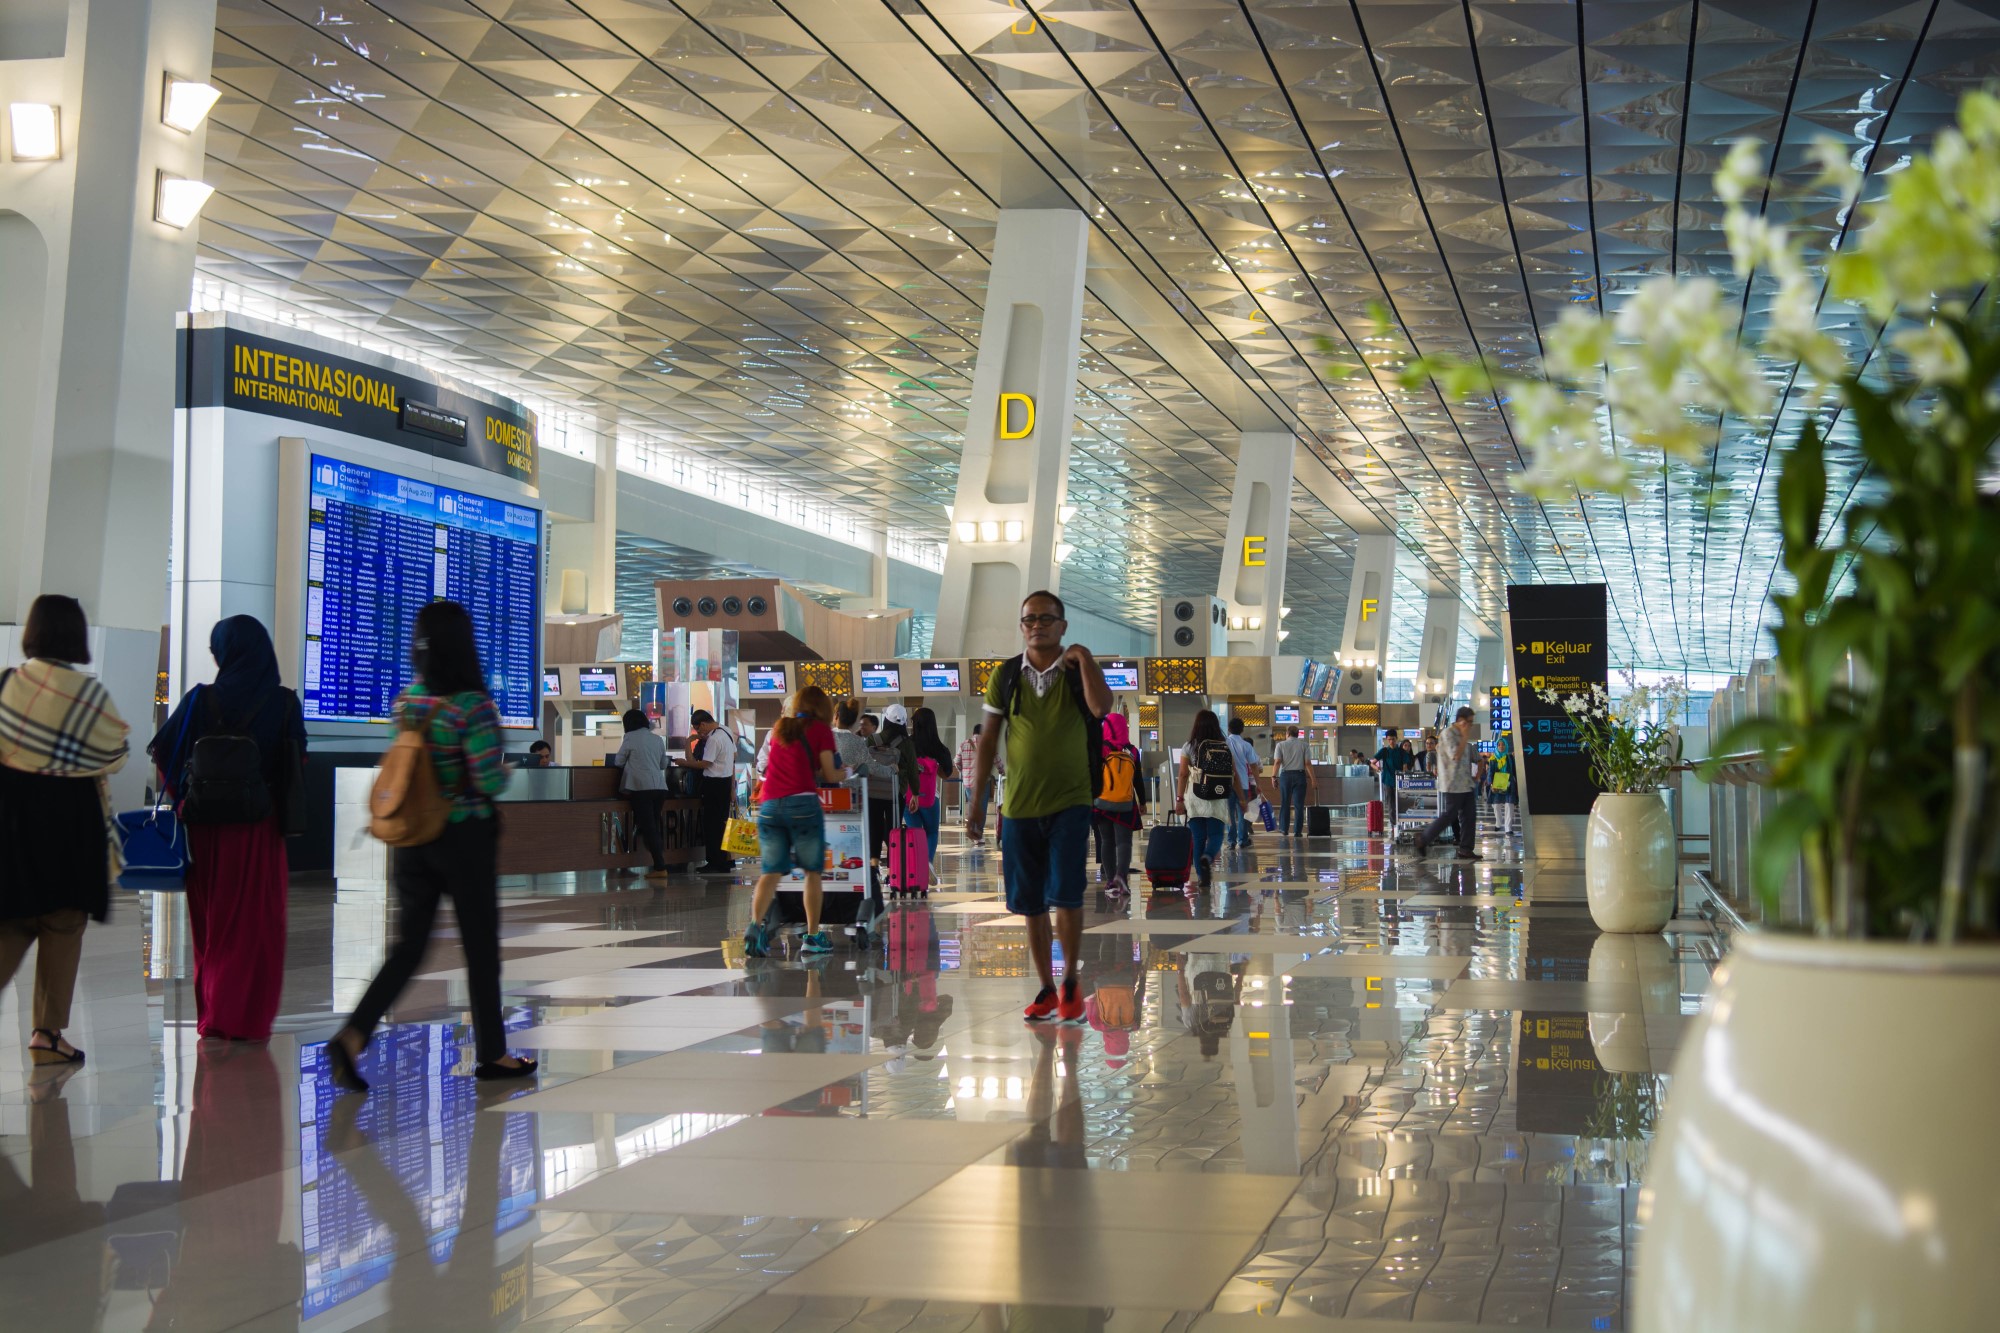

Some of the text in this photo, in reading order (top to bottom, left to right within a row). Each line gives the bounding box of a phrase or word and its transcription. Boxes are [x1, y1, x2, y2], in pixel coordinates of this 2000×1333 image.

[234, 344, 399, 413] INTERNASIONAL
[234, 377, 342, 417] INTERNATIONAL
[1000, 393, 1036, 440] D
[486, 416, 532, 456] DOMESTIK
[507, 450, 532, 474] DOMESTIC
[340, 465, 370, 478] General
[339, 475, 369, 487] Check-in
[339, 482, 366, 494] Terminal
[371, 491, 407, 504] International
[409, 486, 419, 497] Aug
[419, 489, 433, 498] 2017
[458, 494, 484, 507] General
[458, 504, 482, 514] Check-in
[458, 511, 478, 521] Terminal
[1244, 536, 1267, 567] E
[1362, 599, 1378, 621] F
[1546, 641, 1592, 654] Keluar
[1546, 655, 1565, 664] Exit
[1546, 676, 1580, 684] Pelaporan
